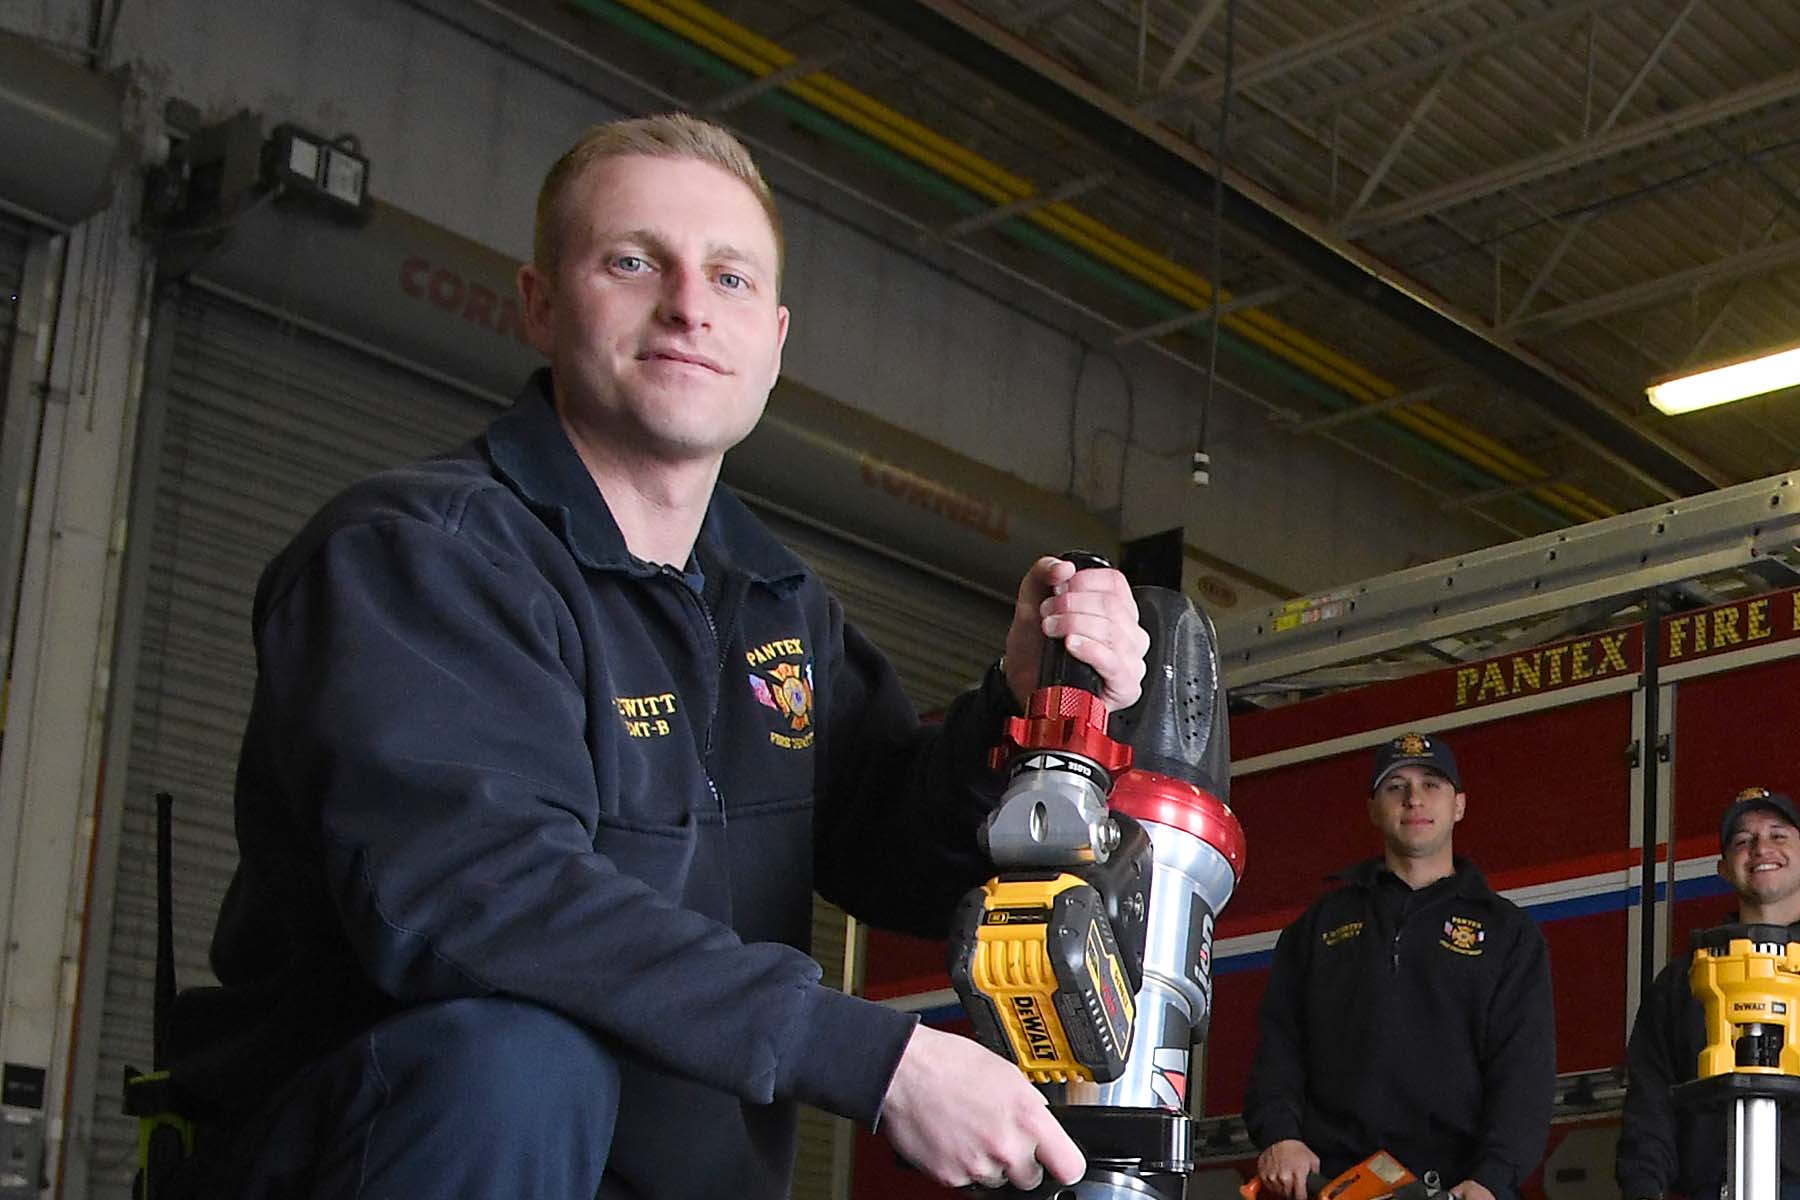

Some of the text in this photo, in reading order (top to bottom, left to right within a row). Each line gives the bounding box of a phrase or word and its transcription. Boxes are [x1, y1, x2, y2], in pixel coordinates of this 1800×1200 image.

[746, 638, 804, 667] PANTEX
[1455, 632, 1629, 705] PANTEX
[1669, 598, 1772, 659] FIRE
[1013, 996, 1056, 1061] DEWALT
